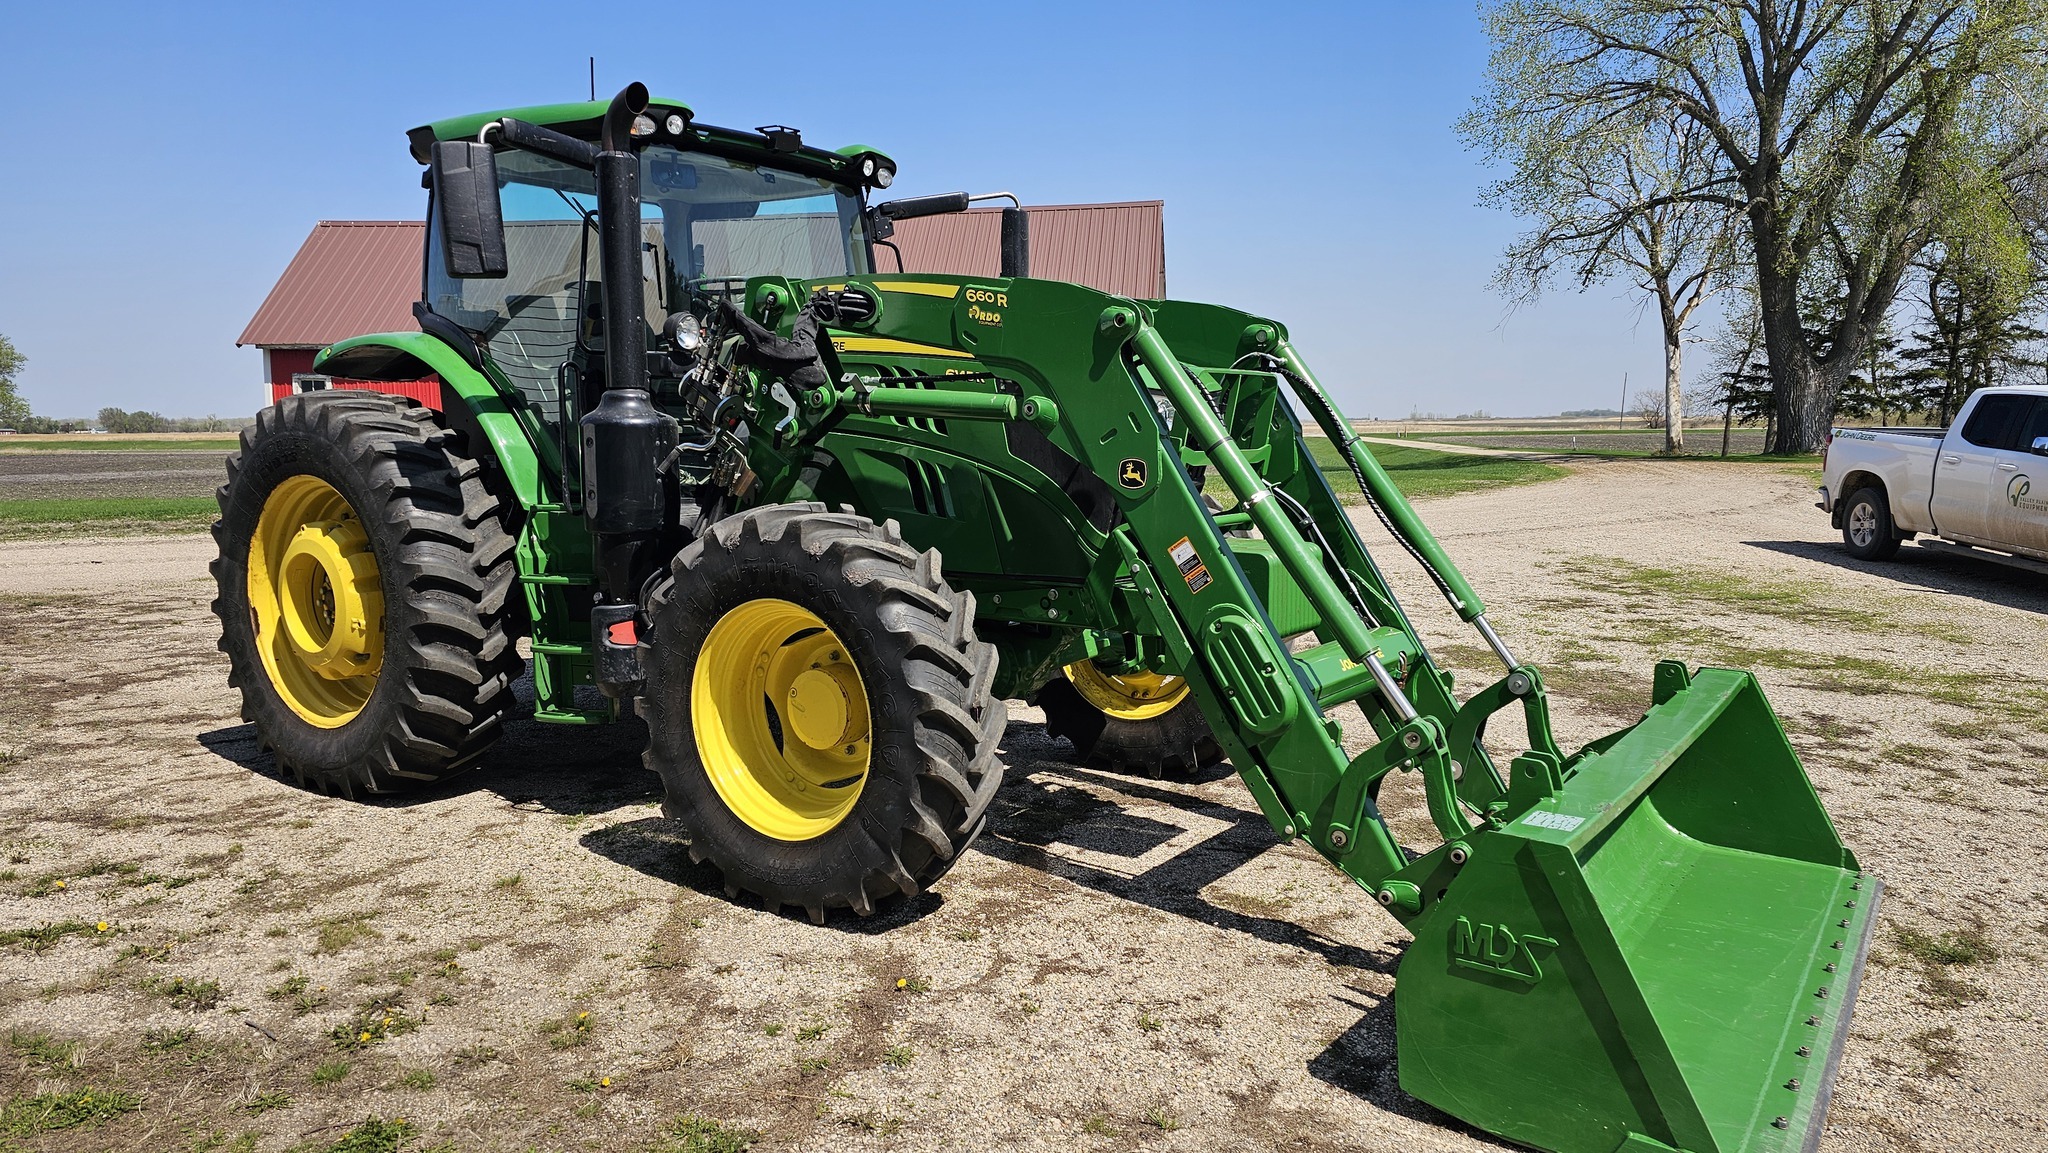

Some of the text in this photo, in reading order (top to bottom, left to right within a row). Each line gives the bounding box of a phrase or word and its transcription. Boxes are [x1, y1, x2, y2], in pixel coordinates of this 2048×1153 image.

[965, 288, 1008, 308] 660 R
[1840, 430, 1878, 442] JOHN DEERE
[1455, 914, 1560, 985] MDS
